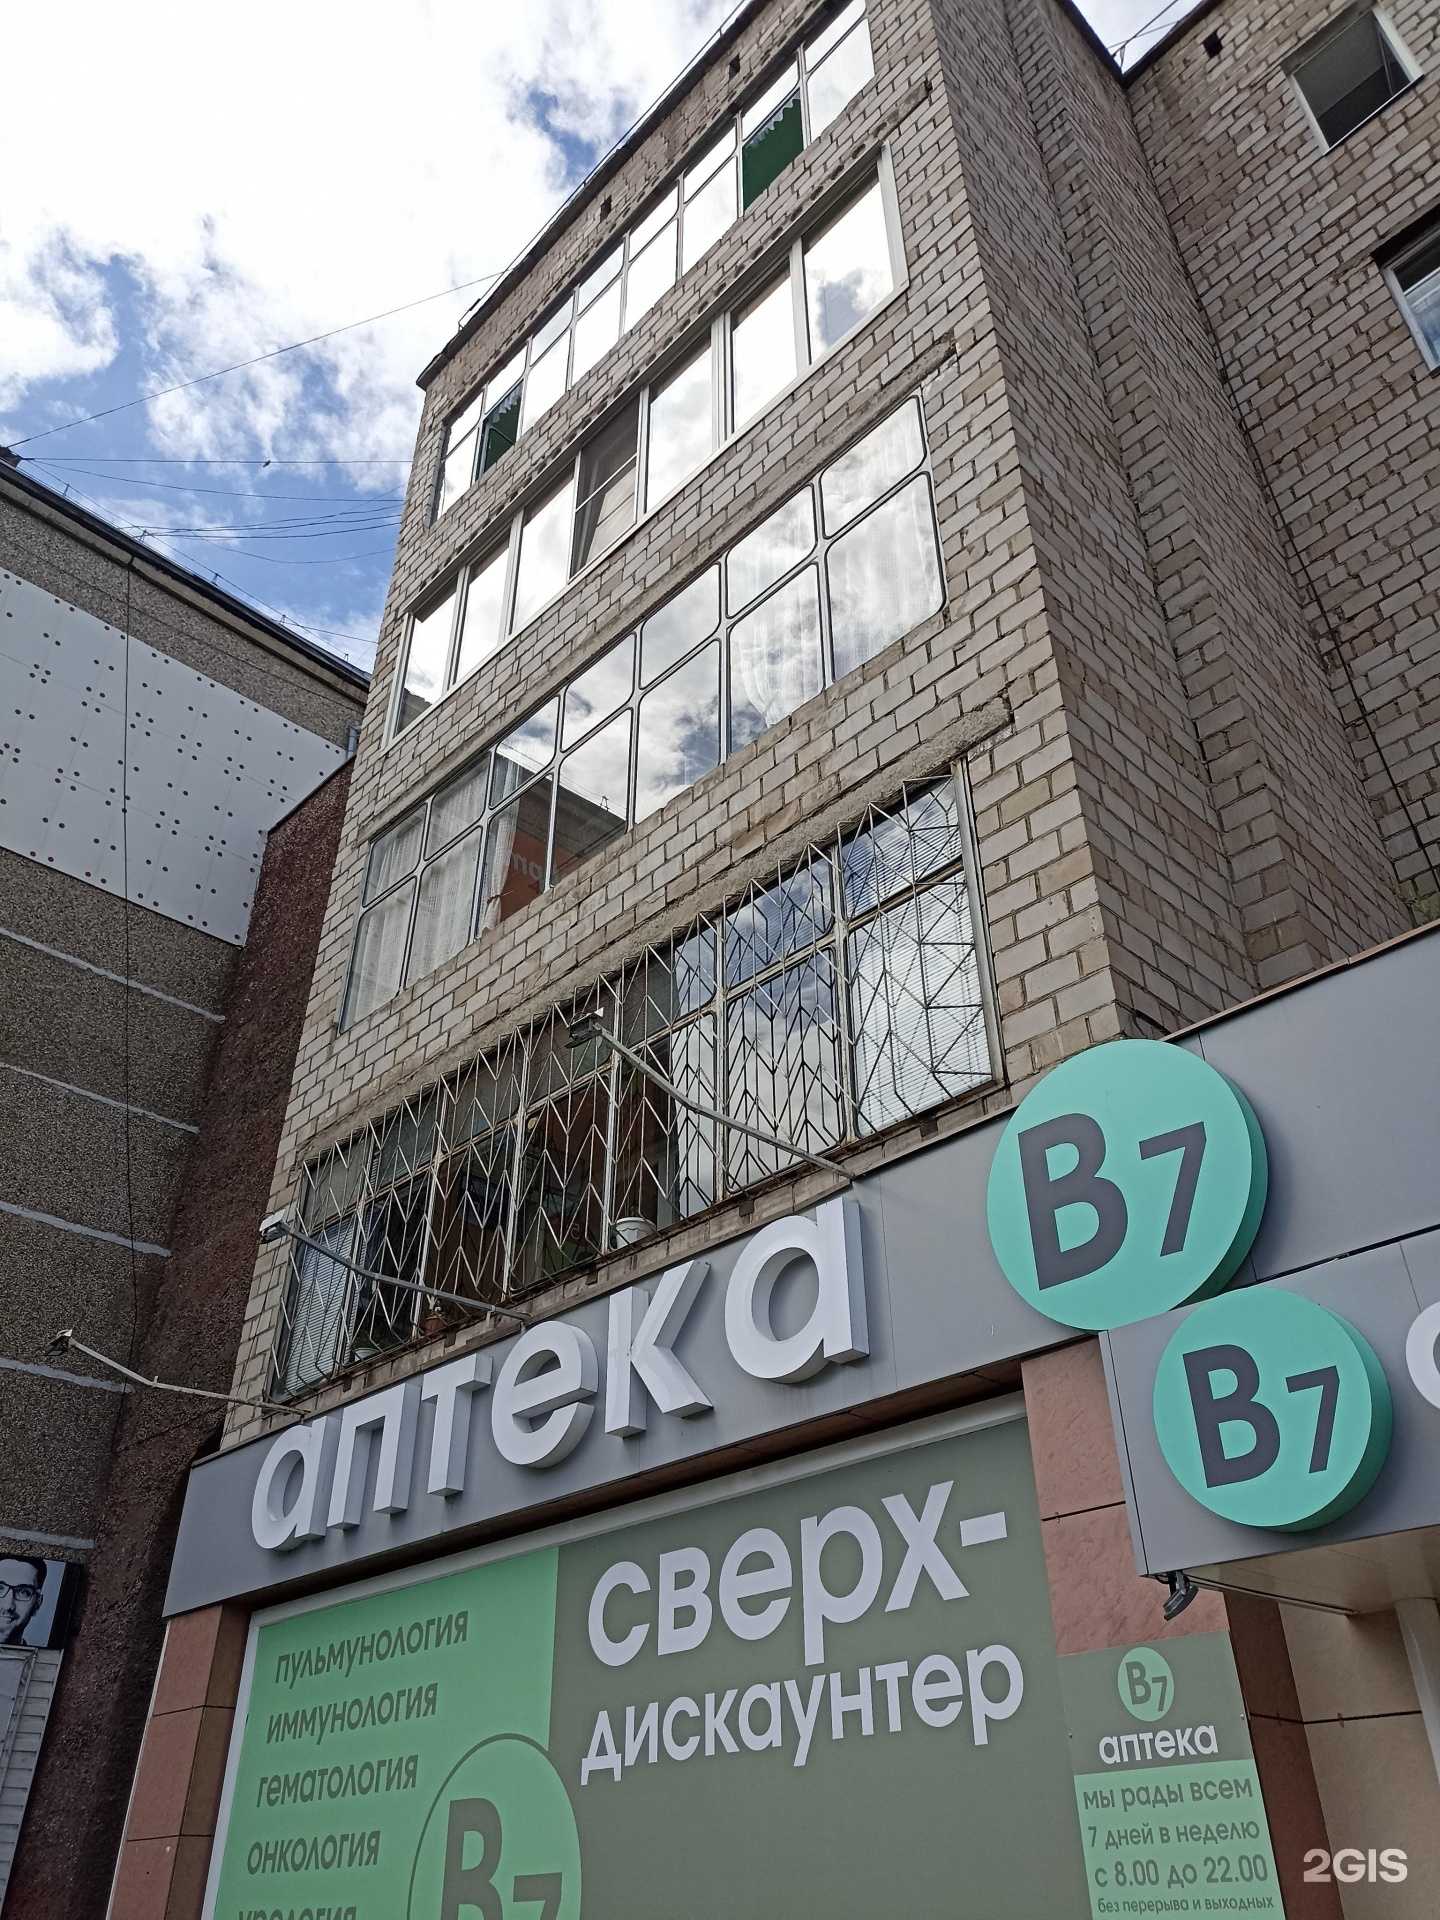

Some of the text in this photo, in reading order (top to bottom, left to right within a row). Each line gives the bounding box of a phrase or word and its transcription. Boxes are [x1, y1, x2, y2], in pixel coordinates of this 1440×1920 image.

[251, 1196, 869, 1553] аптека
[588, 1480, 1008, 1666] сверх-
[274, 1610, 469, 1690] пульмунология
[266, 1682, 438, 1745] иммунология
[580, 1644, 1024, 1786] дискаунтер
[1098, 1723, 1219, 1765] аптека
[256, 1754, 419, 1808] гематология
[1083, 1777, 1254, 1812] мы рады всем
[247, 1830, 381, 1875] онкология
[1087, 1820, 1261, 1850] 7 дней в неделю
[1094, 1853, 1269, 1889] с 8.00 до 22.00
[1098, 1896, 1275, 1915] без перерыва и выходных
